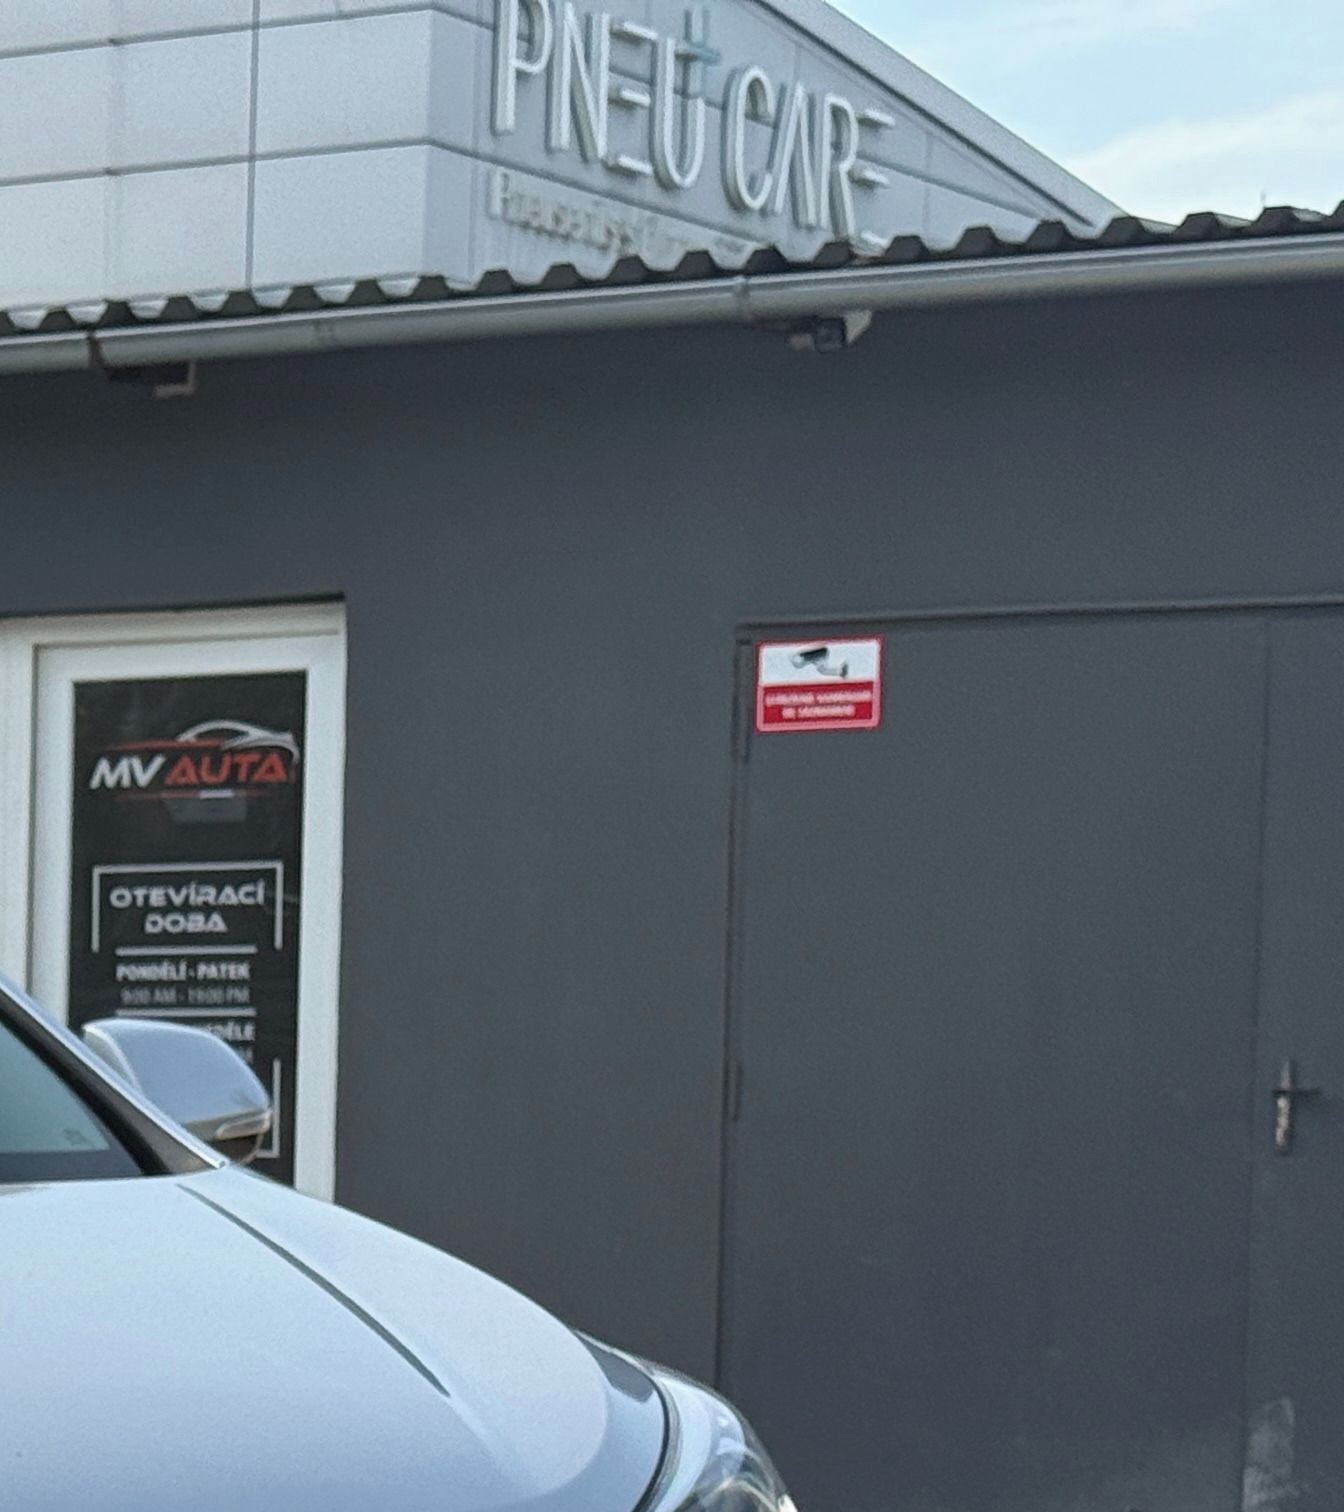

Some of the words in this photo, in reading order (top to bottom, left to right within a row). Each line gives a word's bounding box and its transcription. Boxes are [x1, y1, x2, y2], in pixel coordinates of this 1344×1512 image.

[490, 0, 706, 190] PNEU
[722, 65, 895, 254] CARE
[89, 753, 166, 789] MV
[164, 750, 288, 786] AUTA
[109, 878, 265, 909] OTEVÍRACÍ
[144, 911, 228, 934] DOBA
